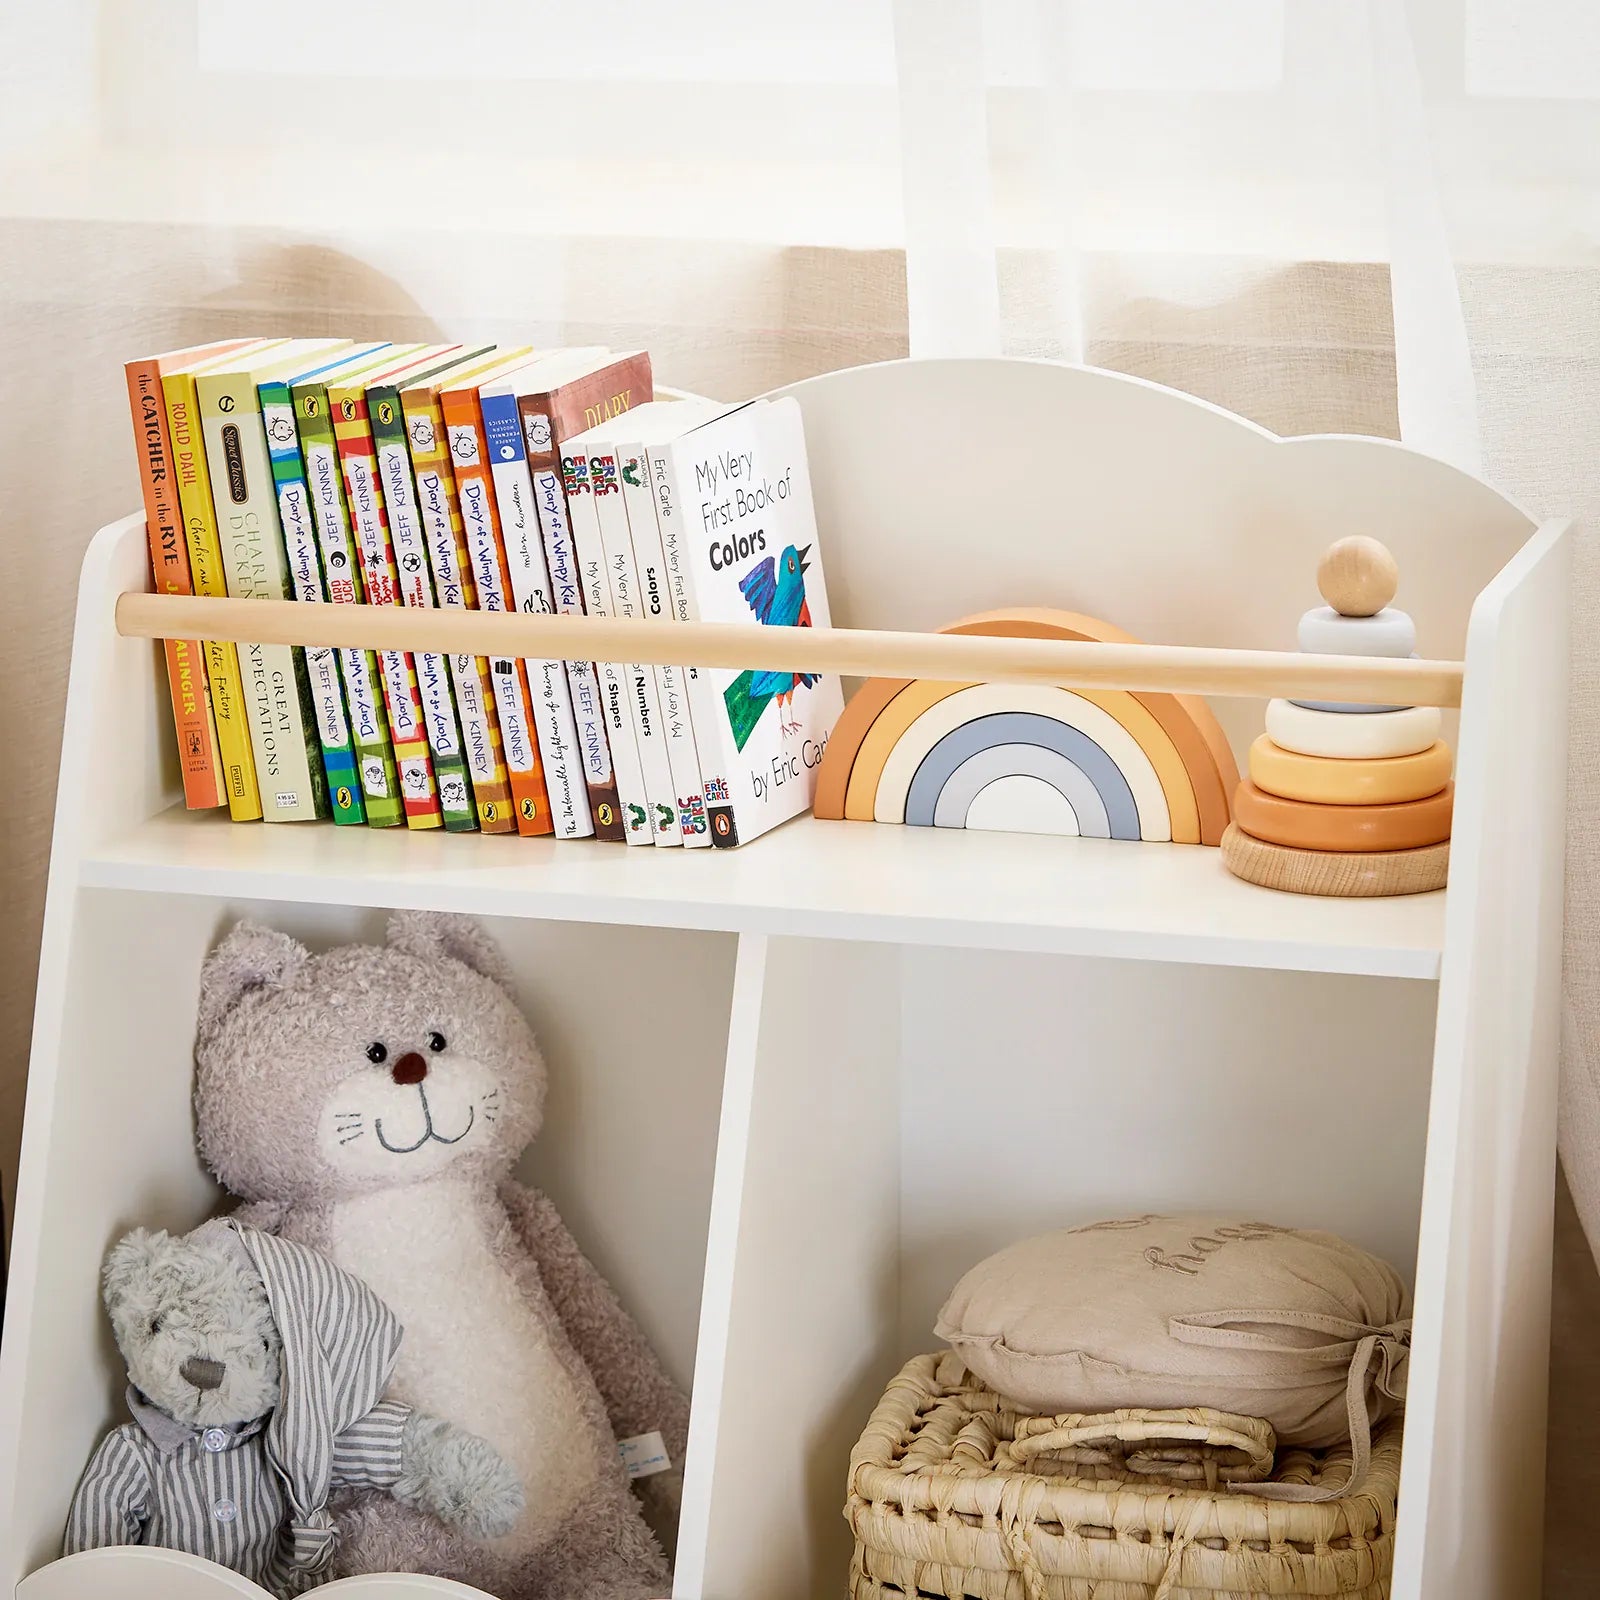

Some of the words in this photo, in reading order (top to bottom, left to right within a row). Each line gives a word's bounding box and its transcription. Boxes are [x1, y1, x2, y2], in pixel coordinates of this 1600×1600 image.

[138, 374, 152, 393] the
[141, 395, 166, 483] CATCHER
[172, 403, 190, 445] ROALD
[179, 452, 196, 487] DAHL
[316, 454, 334, 506] KINNEY
[387, 452, 406, 507] KINNEY
[562, 456, 579, 496] CARLE
[589, 457, 607, 497] CARLE
[654, 459, 665, 481] Eric
[695, 460, 718, 496] My
[718, 451, 752, 481] Very
[154, 488, 165, 498] in
[354, 464, 371, 512] KINNEY
[423, 475, 442, 515] Diary
[465, 484, 483, 523] Diary
[540, 475, 559, 515] Diary
[658, 485, 672, 517] Carle
[702, 499, 734, 533] First
[736, 478, 774, 518] Book
[777, 467, 792, 499] of
[157, 503, 171, 523] the
[286, 490, 302, 524] Diary
[436, 517, 445, 528] of
[552, 517, 561, 529] of
[189, 517, 209, 563] Charlie
[296, 526, 305, 536] of
[325, 512, 339, 543] JEFF
[363, 518, 377, 548] JEFF
[397, 514, 412, 546] JEFF
[477, 526, 487, 537] of
[666, 533, 677, 549] My
[160, 525, 179, 566] RYE
[230, 516, 253, 599] DICKEN
[244, 512, 269, 599] CHARLE
[437, 539, 452, 582] Wimpy
[553, 540, 568, 583] Wimpy
[668, 550, 679, 573] Very
[709, 529, 766, 571] Colors
[297, 545, 310, 582] Wimpy
[478, 548, 493, 589] Wimpy
[587, 561, 597, 579] My
[613, 554, 625, 572] My
[303, 584, 316, 601] Kid
[342, 579, 356, 604] UCK
[444, 584, 459, 605] Kid
[485, 591, 500, 612] Kid
[560, 585, 575, 606] Kid
[591, 580, 602, 612] Very
[618, 573, 629, 601] Very
[646, 567, 661, 615] Colors
[674, 576, 684, 596] First
[623, 604, 633, 618] Fir
[175, 640, 196, 716] ALINGER
[318, 663, 331, 690] JEFF
[349, 649, 363, 678] Wim
[423, 653, 439, 688] Wimp
[606, 669, 617, 680] of
[663, 665, 674, 689] First
[354, 687, 364, 698] of
[392, 680, 402, 691] of
[463, 682, 477, 714] JEFF
[501, 678, 516, 708] JEFF
[578, 682, 594, 715] JEFF
[249, 644, 279, 776] XPECTATIONS
[272, 671, 291, 734] GREAT
[395, 693, 412, 729] Diary
[430, 699, 439, 711] of
[608, 684, 622, 729] Shapes
[635, 677, 651, 737] Numbers
[668, 692, 679, 719] Very
[323, 696, 340, 743] KINNEY
[357, 701, 374, 738] Diary
[433, 713, 451, 751] Diary
[672, 721, 683, 738] My
[469, 720, 488, 774] KINNEY
[507, 715, 525, 766] KINNEY
[585, 722, 603, 776] KINNEY
[232, 767, 242, 795] PUFFIN
[751, 770, 768, 803] by
[771, 752, 799, 787] Eric
[802, 731, 829, 769] Car
[705, 782, 728, 792] ERIC
[706, 791, 729, 801] CARLE
[691, 795, 707, 835] CARLE
